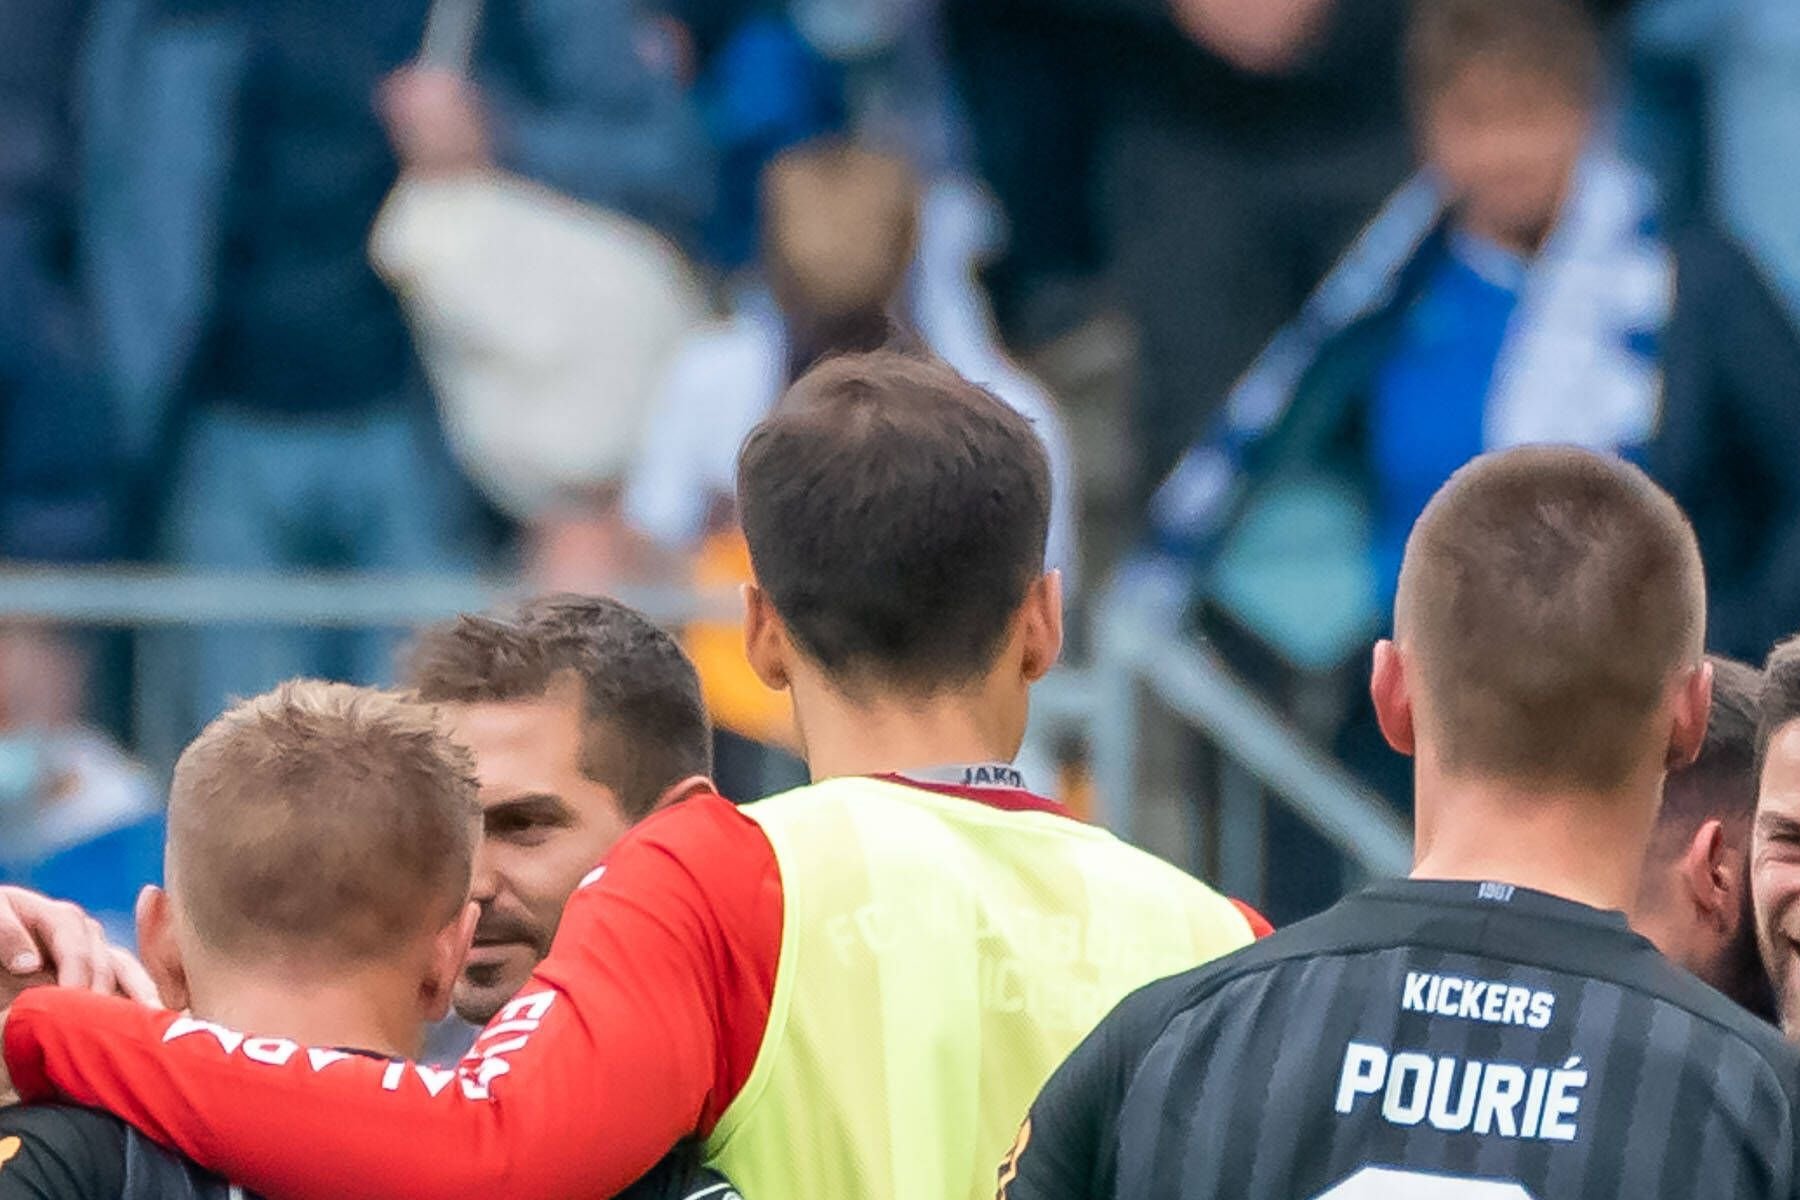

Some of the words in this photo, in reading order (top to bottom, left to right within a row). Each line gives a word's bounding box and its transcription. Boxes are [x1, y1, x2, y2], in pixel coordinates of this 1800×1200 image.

[964, 766, 1022, 788] JAKO
[1402, 971, 1555, 1029] KICKERS
[1335, 1042, 1588, 1141] POURIÉ
